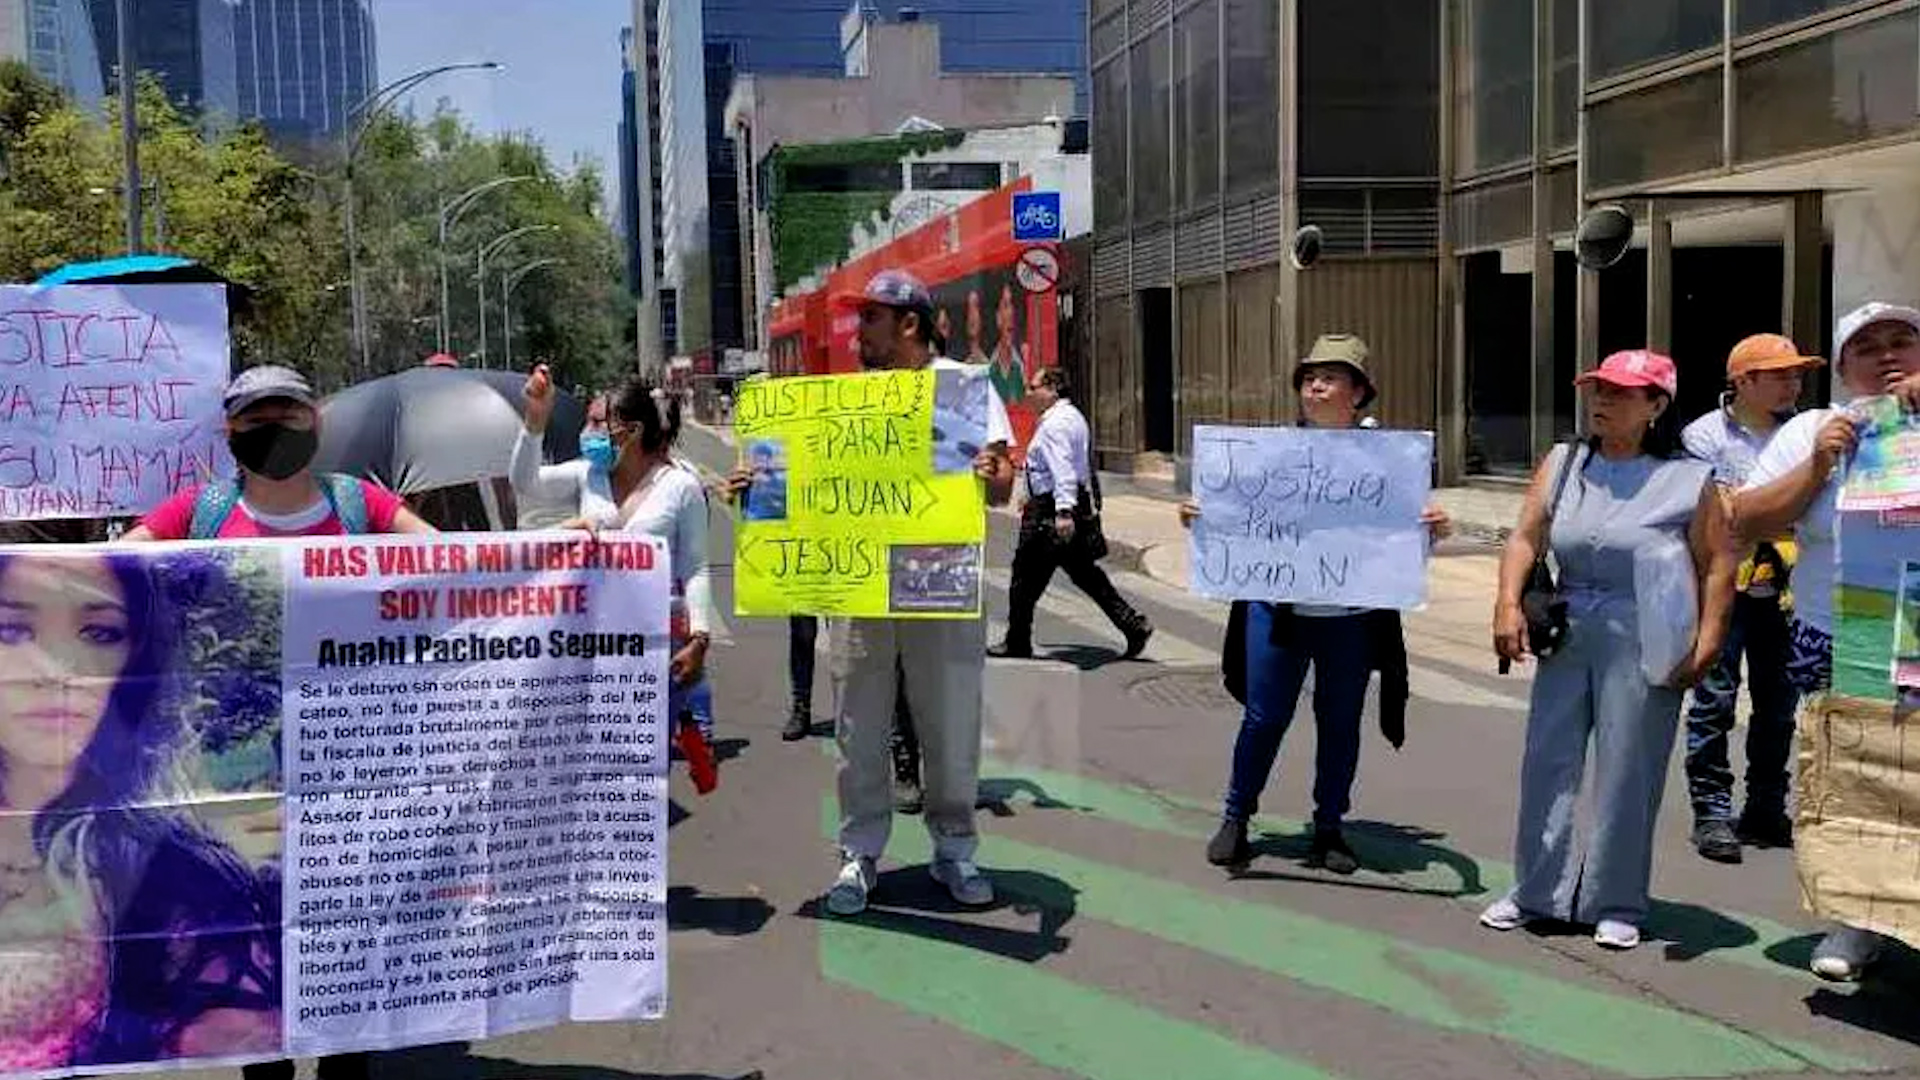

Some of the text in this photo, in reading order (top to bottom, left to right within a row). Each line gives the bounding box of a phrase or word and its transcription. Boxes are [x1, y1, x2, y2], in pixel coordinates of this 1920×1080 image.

[746, 376, 903, 420] JUSTICIA
[824, 418, 903, 460] PARA
[304, 541, 654, 577] HAS VALER MI LIBERTAD
[1201, 537, 1297, 588] Juan
[380, 585, 588, 620] SOY INOCENTE
[414, 632, 541, 664] Pacheco
[547, 629, 646, 659] Segura
[633, 691, 657, 704] MP
